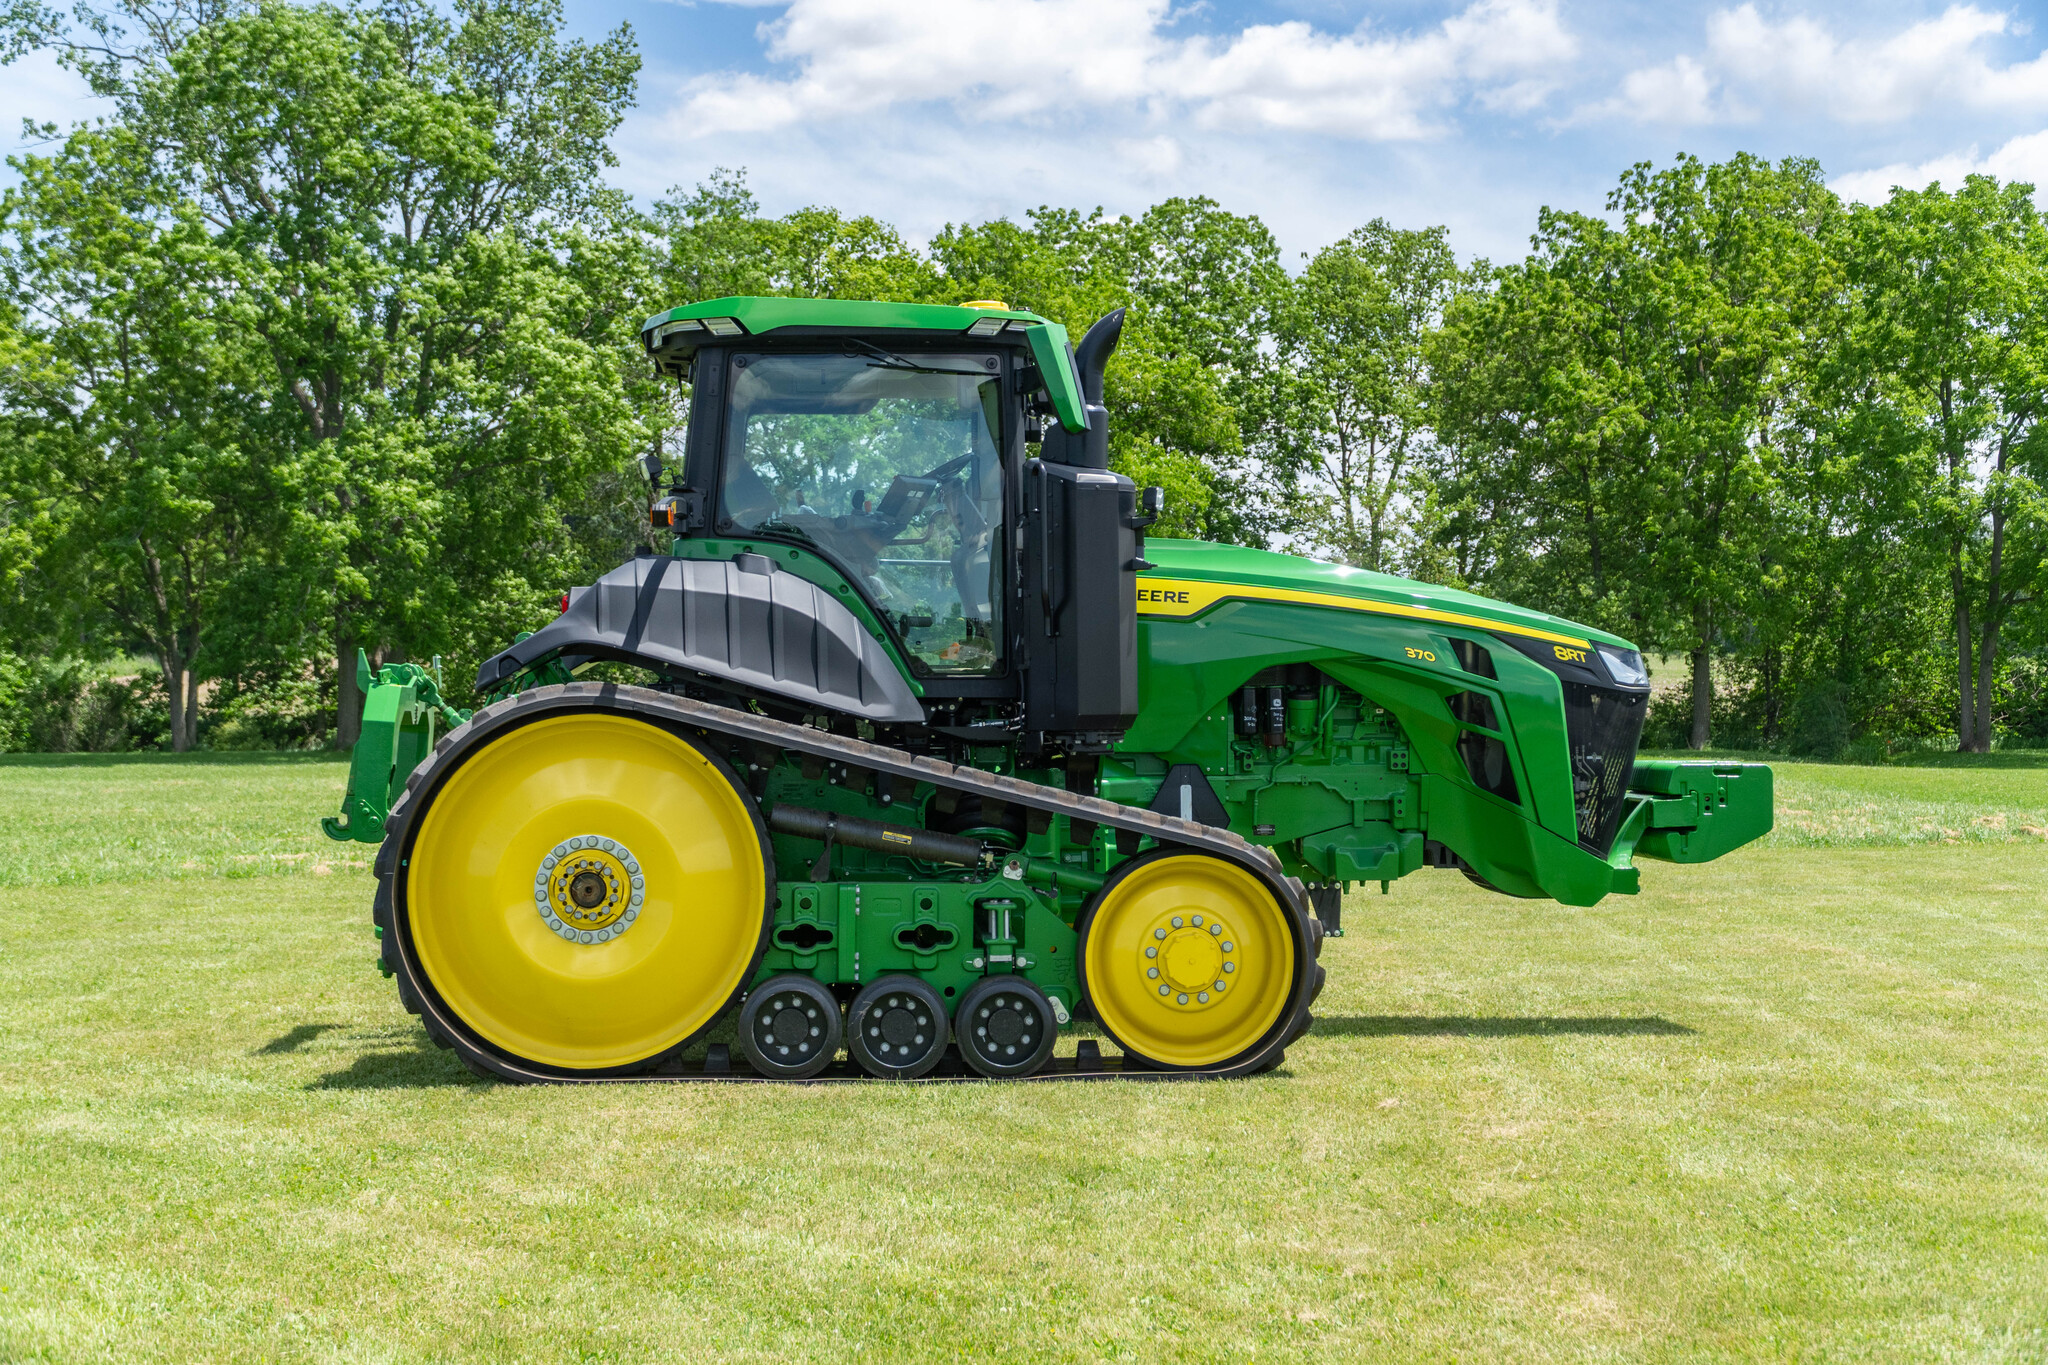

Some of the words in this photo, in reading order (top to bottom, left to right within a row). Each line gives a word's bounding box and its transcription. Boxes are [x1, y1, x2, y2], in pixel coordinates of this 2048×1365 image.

[1137, 589, 1190, 604] EERE
[1404, 646, 1436, 662] 370
[1553, 645, 1587, 663] 8RT
